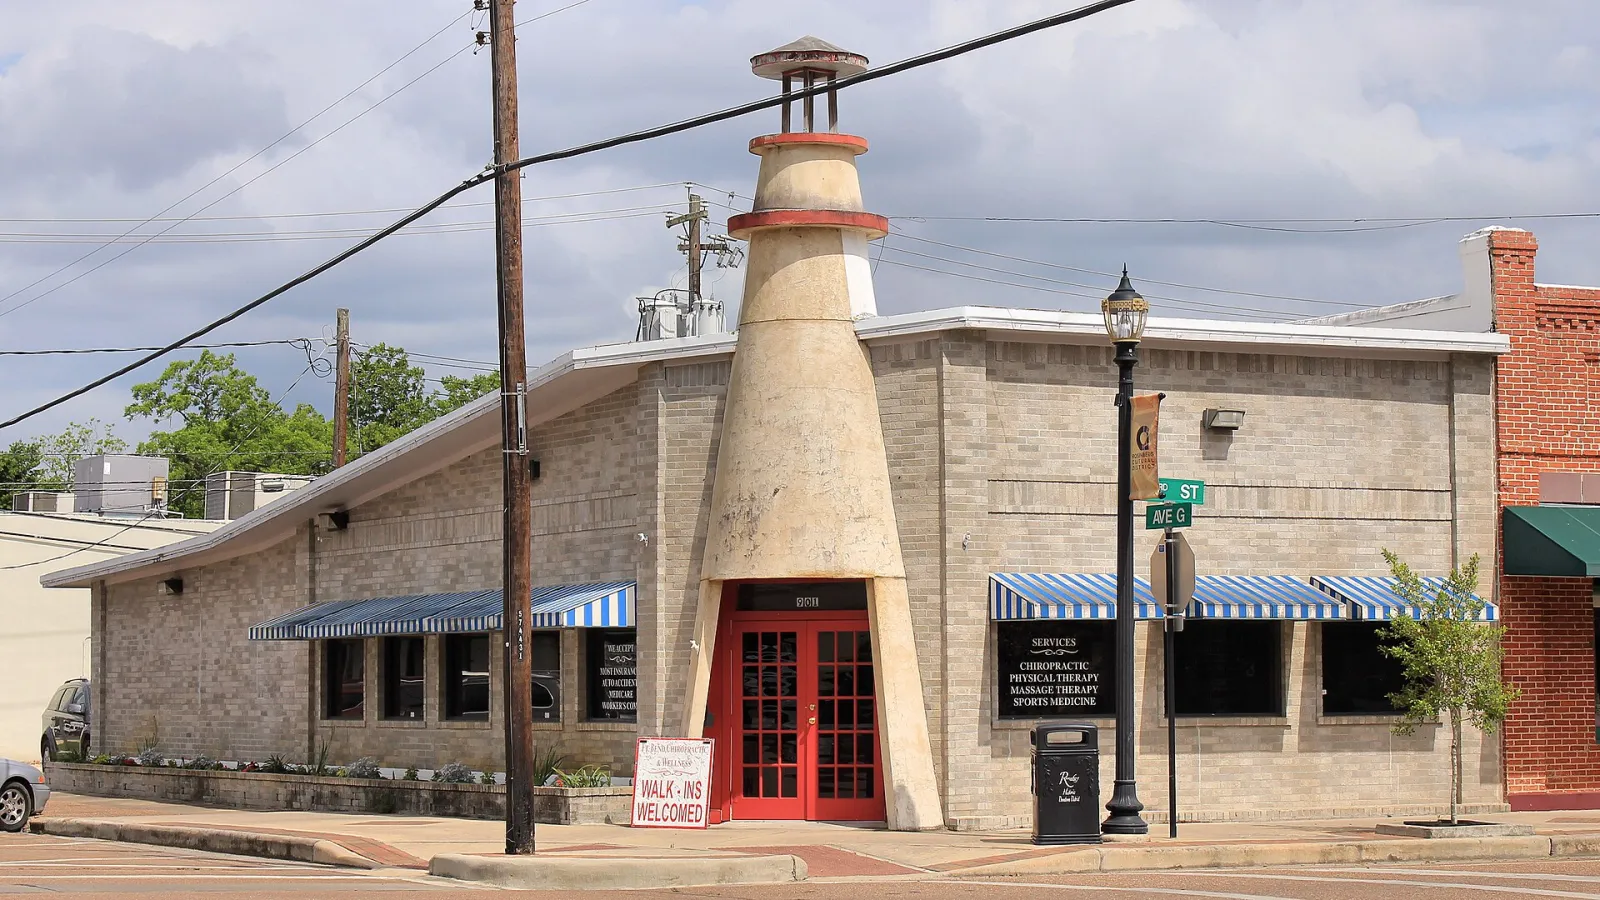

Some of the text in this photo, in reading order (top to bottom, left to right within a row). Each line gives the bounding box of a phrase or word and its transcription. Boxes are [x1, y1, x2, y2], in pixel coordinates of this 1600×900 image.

[1159, 483, 1199, 499] RD ST
[1152, 508, 1185, 524] AVE G
[796, 597, 819, 607] 901
[1032, 638, 1076, 647] SERVICES
[607, 644, 634, 652] WE ACCEPT
[1020, 661, 1089, 670] CHIROPRACTIC
[600, 667, 637, 676] MOST INSURANC
[1009, 673, 1099, 682] PHYSICAL THERAPY
[602, 679, 615, 687] AUTO
[1010, 685, 1099, 694] MASSAGE THERAPY
[608, 690, 633, 699] MEDICARE
[626, 702, 637, 710] COM
[1013, 697, 1096, 706] SPORTS MEDICINE
[641, 779, 673, 799] WALK
[683, 780, 702, 800] INS
[637, 802, 703, 823] WELCOMED
